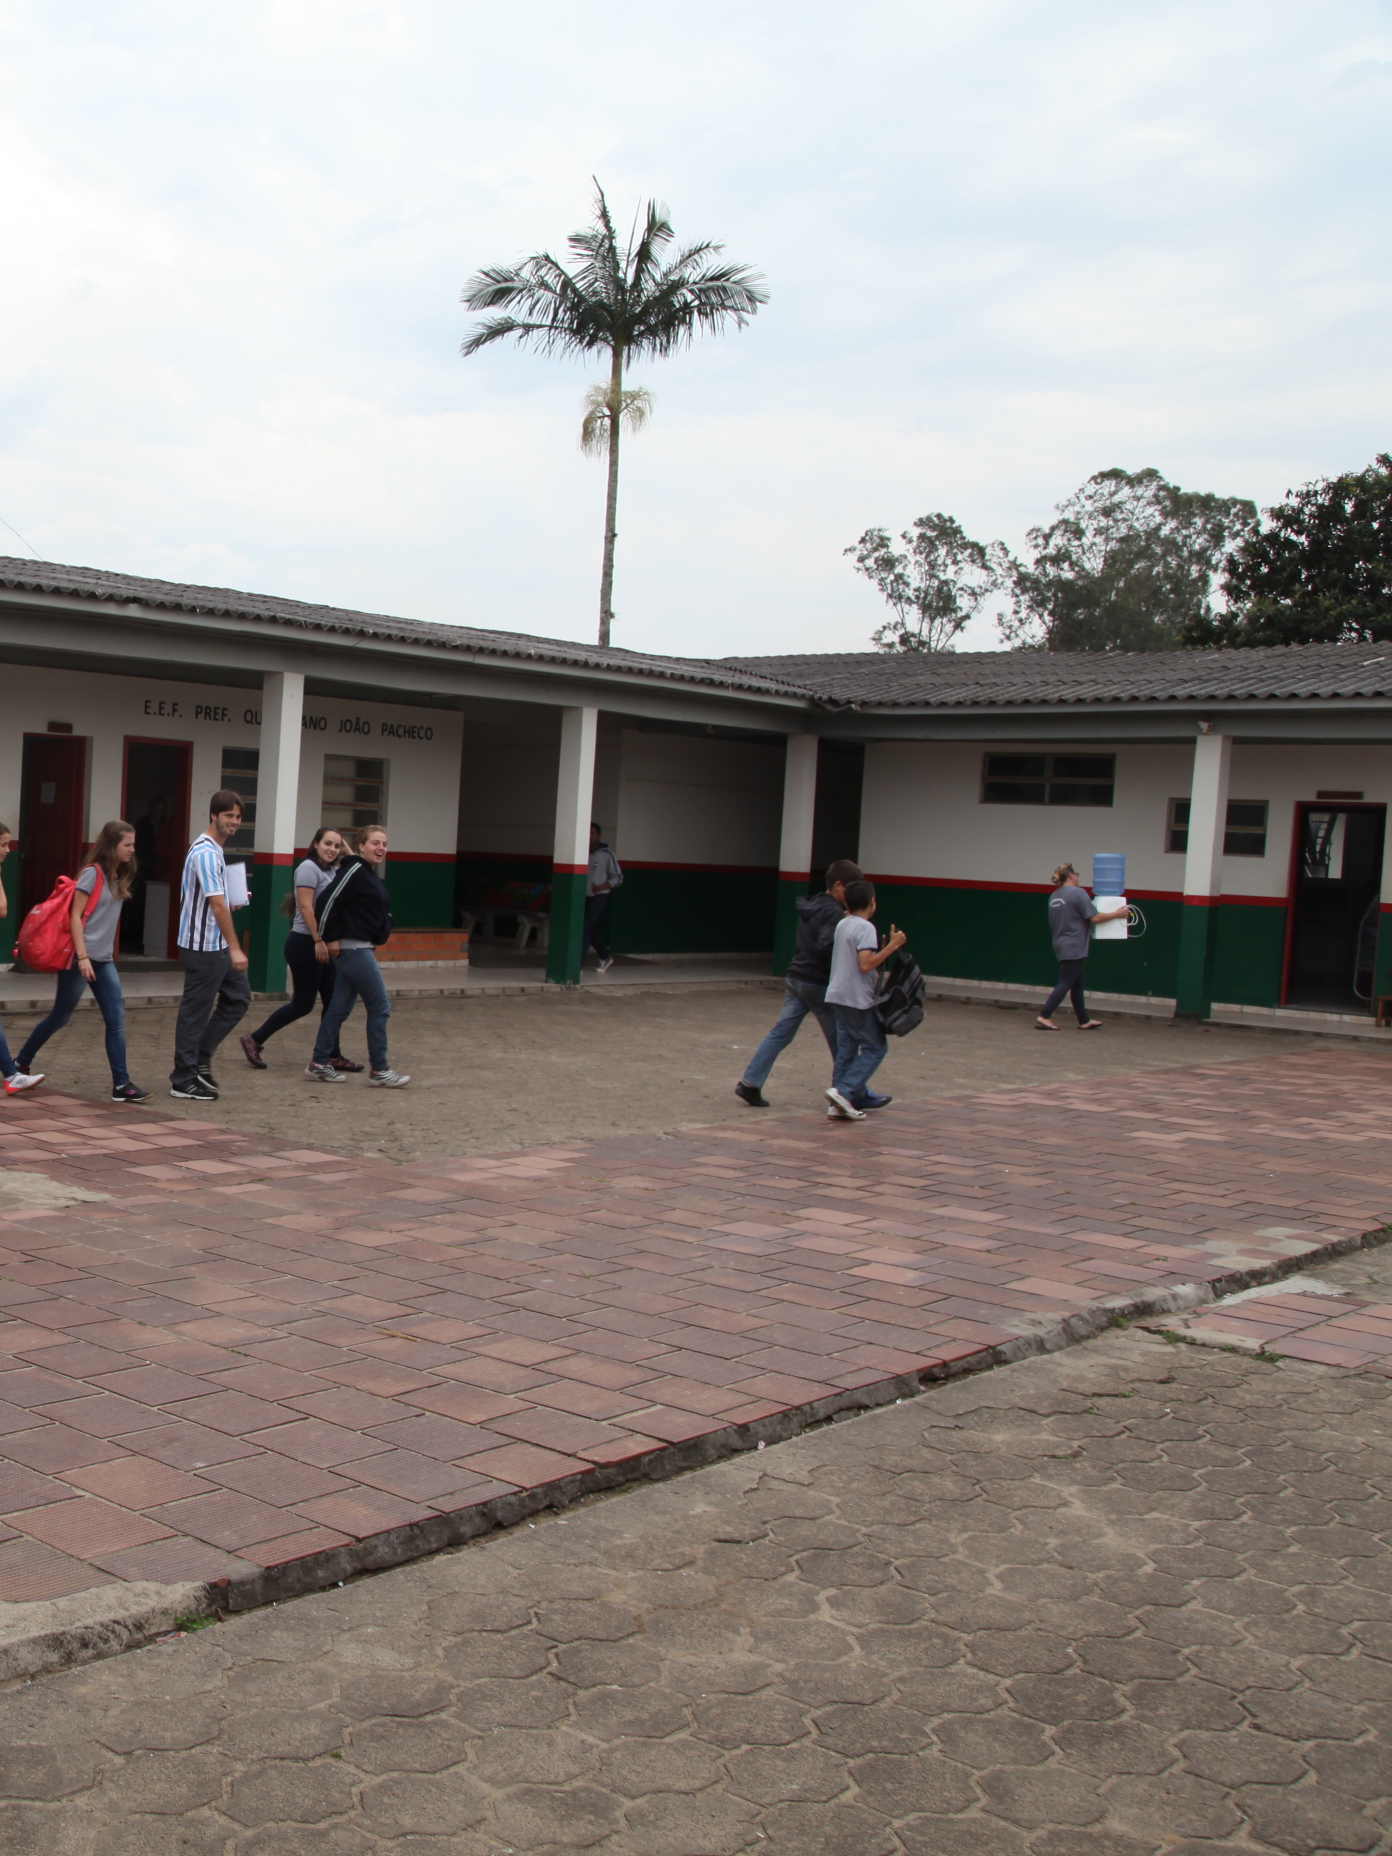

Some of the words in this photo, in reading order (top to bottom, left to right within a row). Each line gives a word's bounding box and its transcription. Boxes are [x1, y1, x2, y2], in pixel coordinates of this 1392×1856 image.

[144, 700, 183, 718] E.E.F.
[195, 704, 231, 722] PREF.
[338, 716, 371, 735] JOÃO
[381, 722, 434, 741] PACHECO
